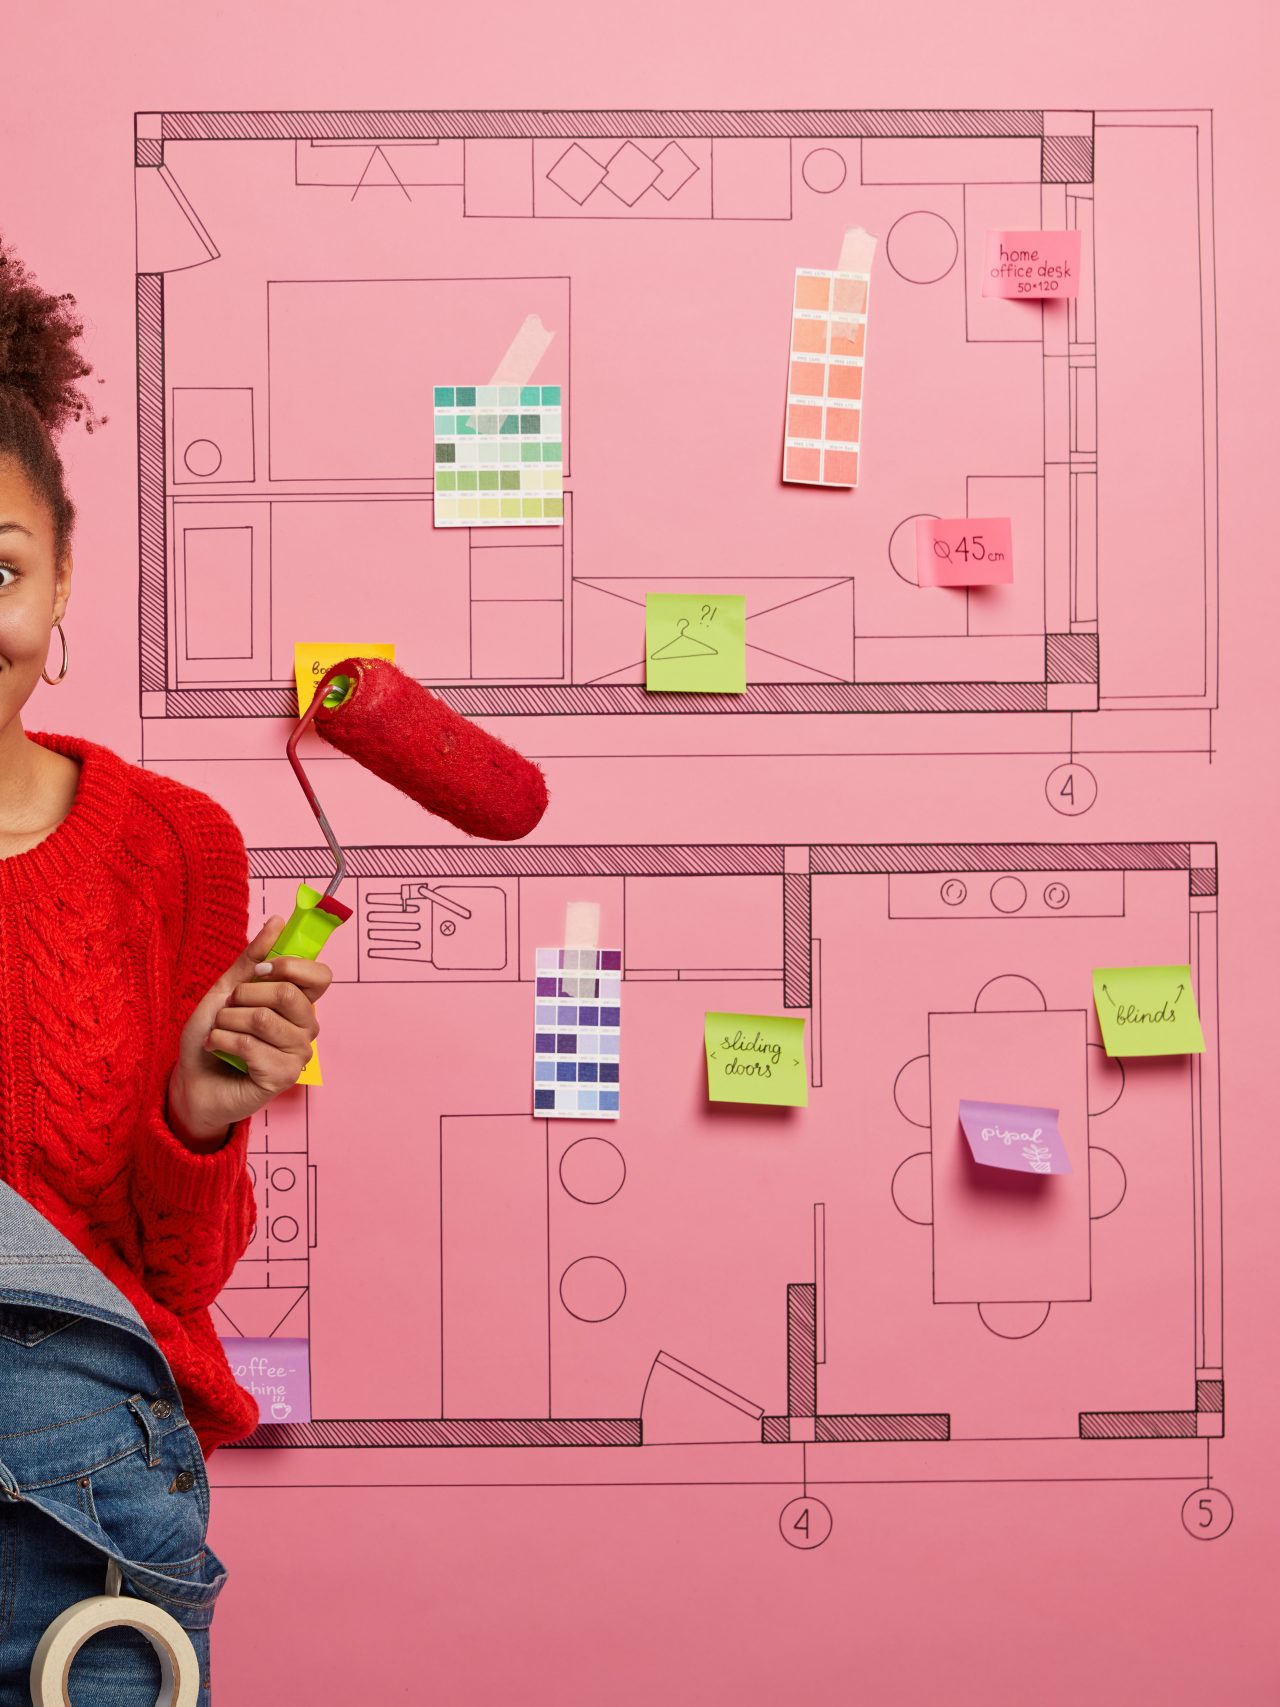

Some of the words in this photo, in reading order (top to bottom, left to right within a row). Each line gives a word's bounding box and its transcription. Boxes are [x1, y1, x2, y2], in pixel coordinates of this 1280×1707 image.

[1000, 243, 1040, 262] home
[990, 263, 1033, 278] office
[1037, 260, 1071, 278] desk
[1060, 774, 1074, 805] 4
[1116, 1001, 1176, 1026] blinds
[720, 1030, 782, 1064] sliding
[725, 1057, 772, 1078] doors
[793, 1508, 809, 1539] 4
[1199, 1499, 1213, 1528] 5
